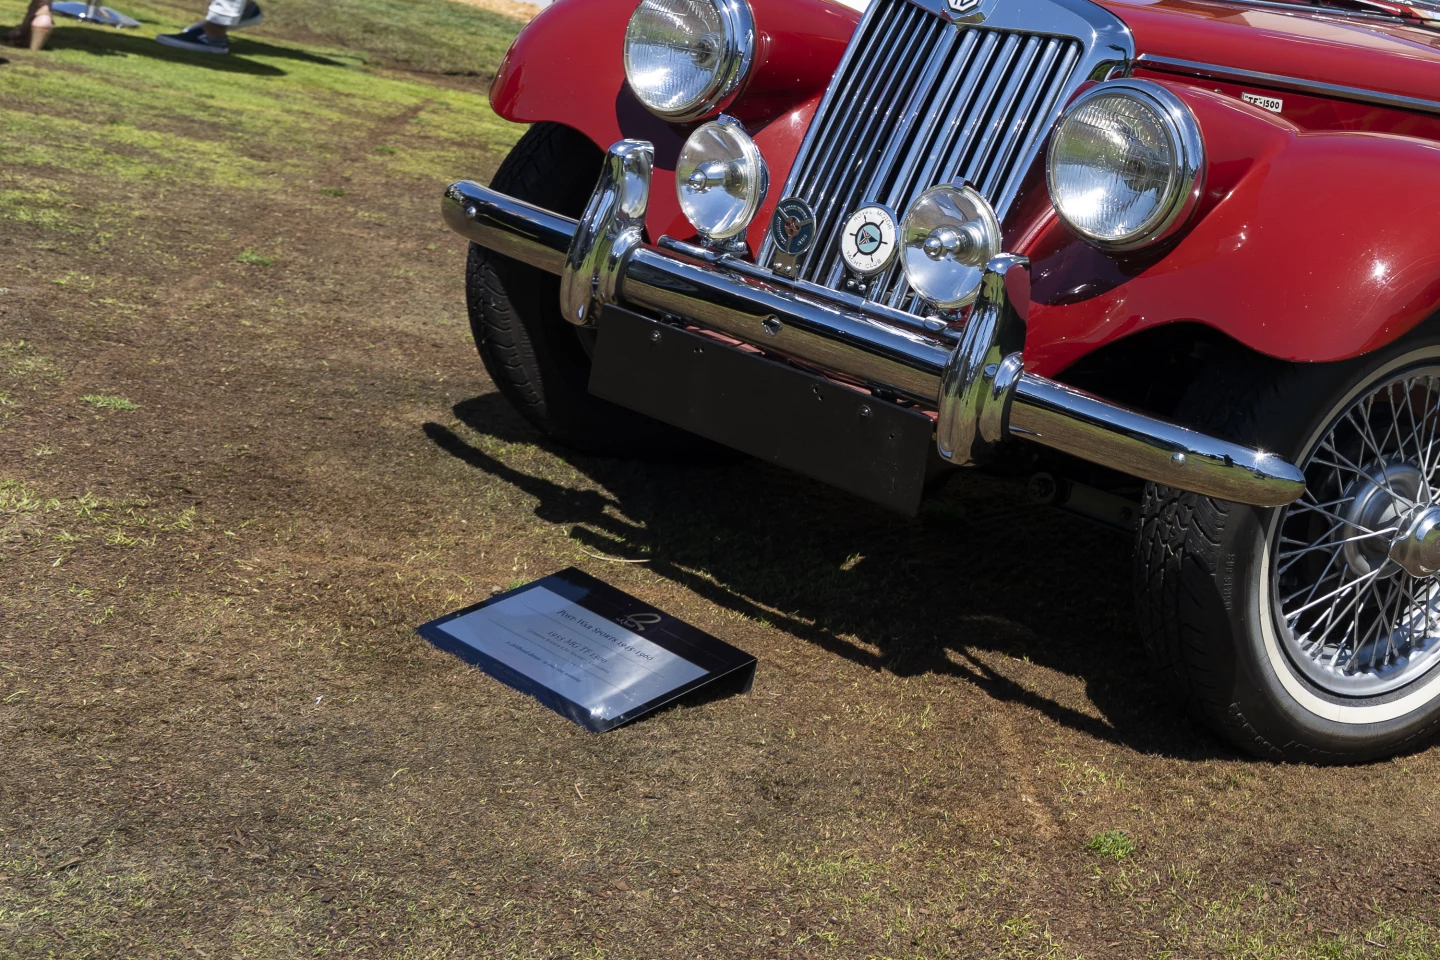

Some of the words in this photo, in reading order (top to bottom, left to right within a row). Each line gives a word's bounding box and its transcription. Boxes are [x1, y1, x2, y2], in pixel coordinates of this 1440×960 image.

[853, 209, 873, 222] ROYAL
[876, 210, 893, 230] MOTOR
[846, 250, 862, 268] YACHT
[865, 258, 882, 270] CLUB
[591, 627, 620, 643] SPORTS
